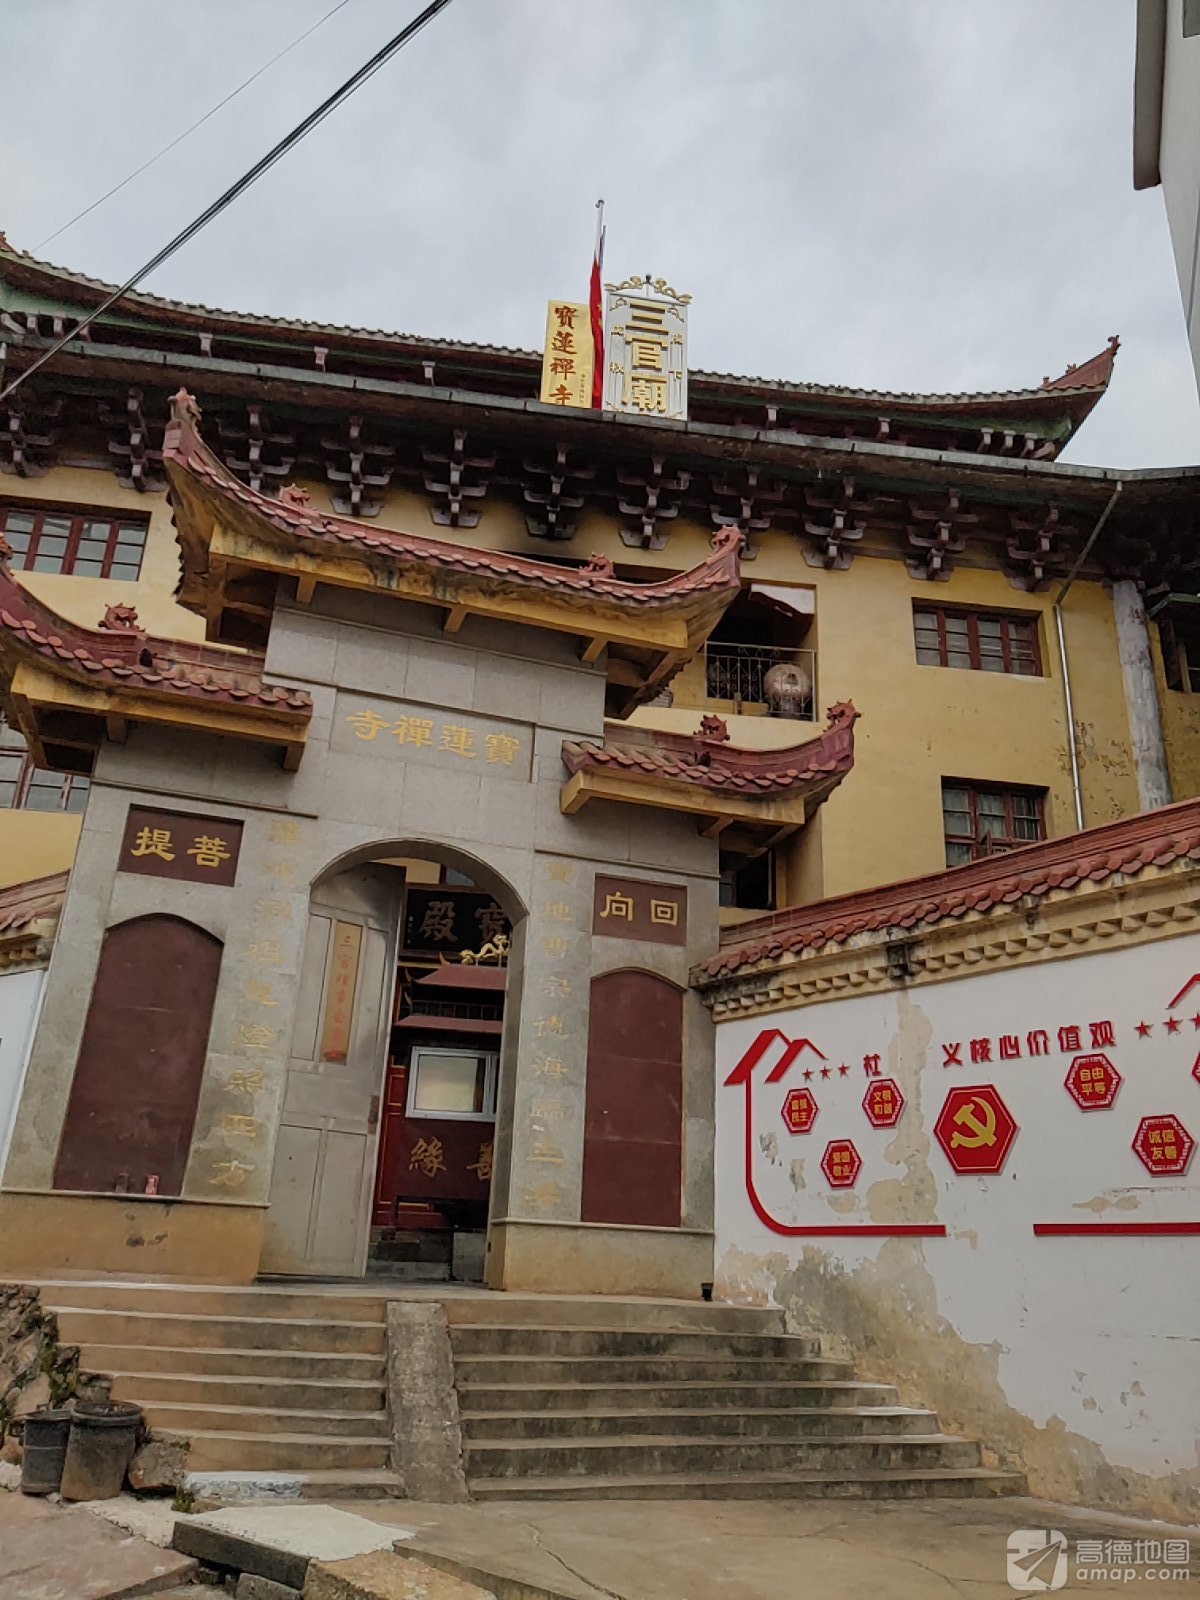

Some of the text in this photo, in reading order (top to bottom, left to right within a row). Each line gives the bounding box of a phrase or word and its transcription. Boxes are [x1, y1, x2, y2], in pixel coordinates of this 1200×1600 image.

[345, 708, 520, 766] 寶蓮禪寺
[130, 826, 231, 868] 菩提
[599, 891, 678, 926] 回向
[942, 1020, 1117, 1068] 义核心价值观
[1080, 1067, 1104, 1081] 自由
